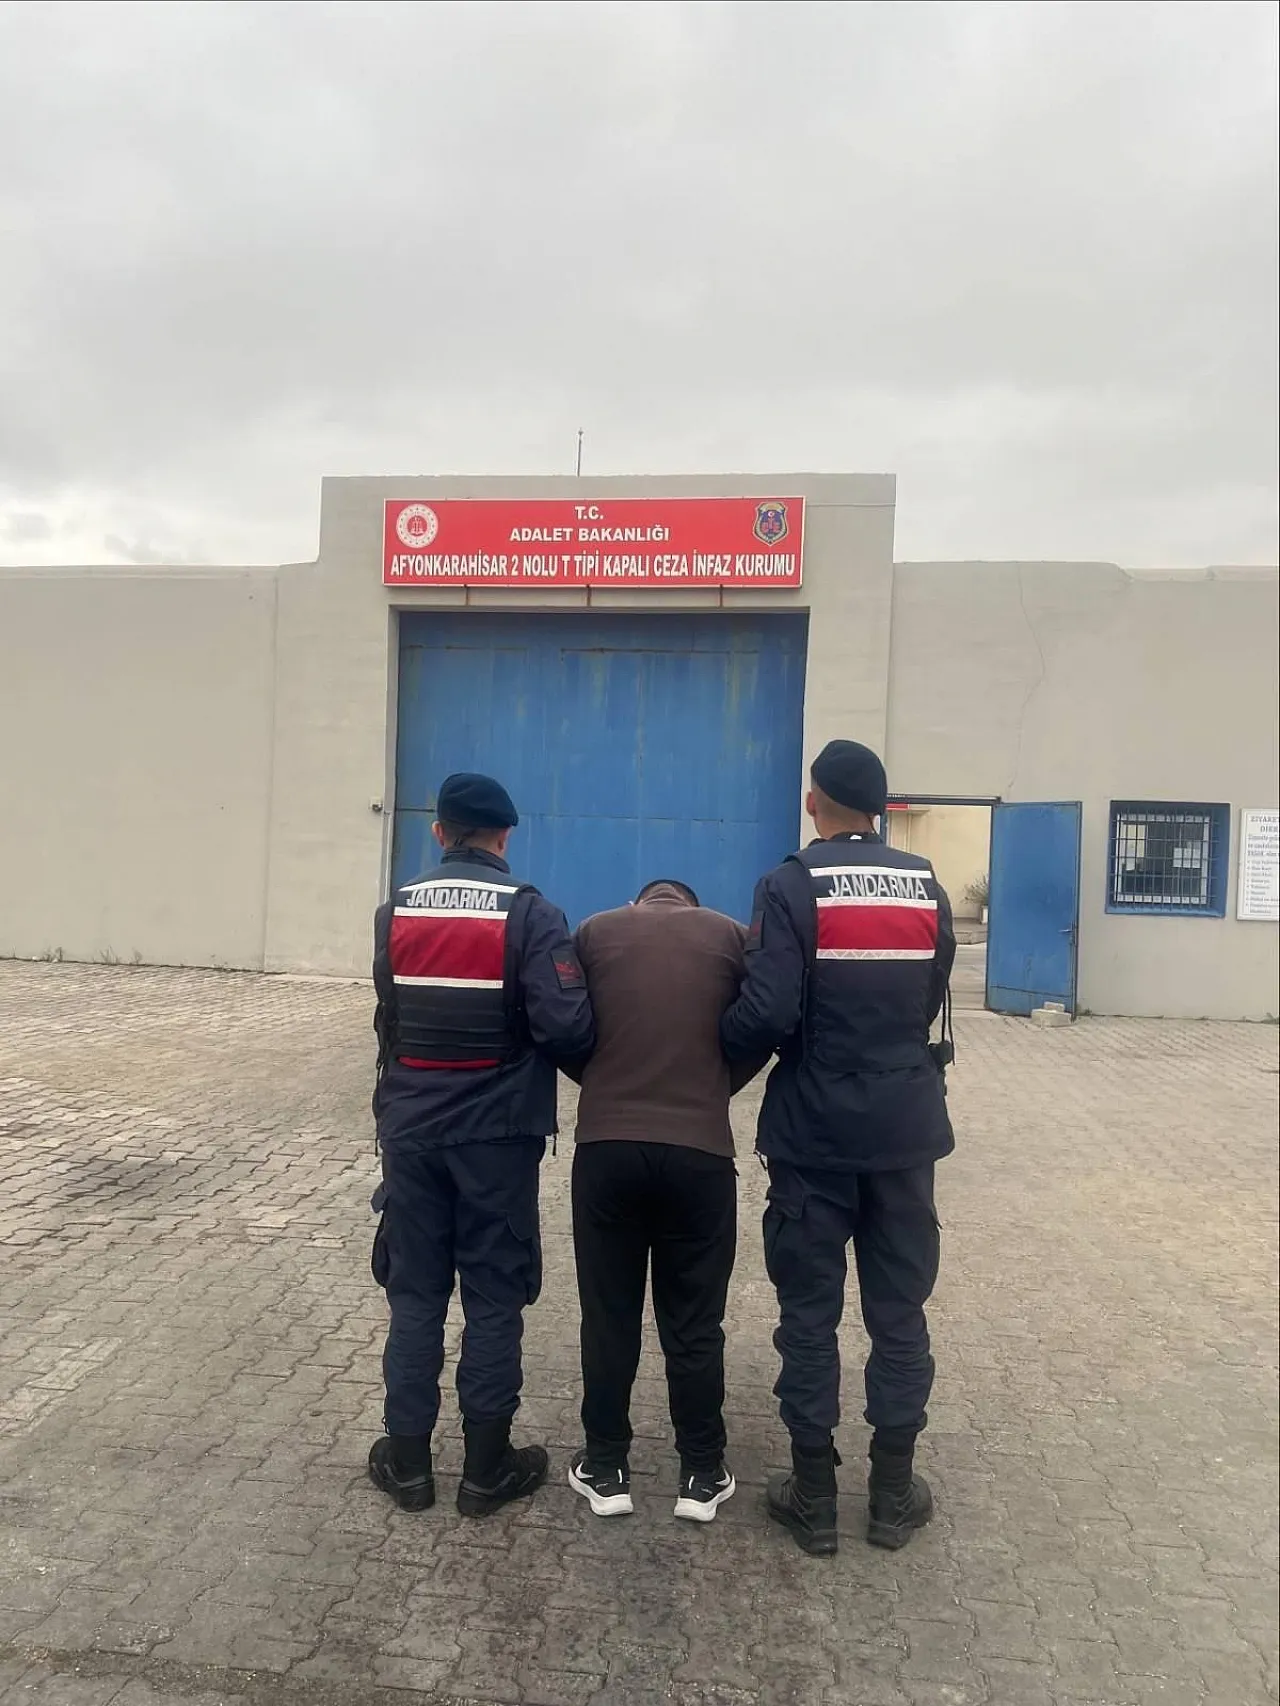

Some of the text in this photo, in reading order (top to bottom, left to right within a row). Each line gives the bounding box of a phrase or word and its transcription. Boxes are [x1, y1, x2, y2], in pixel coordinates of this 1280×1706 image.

[575, 506, 604, 519] T.C.
[510, 524, 670, 541] ADALET BAKANLIĞI
[390, 549, 795, 577] AFYONKARAHİSAR 2 NOLU T TİPİ KAPALI CEZA İNFAZ KURUMU
[406, 887, 499, 910] JANDARMA
[828, 874, 928, 900] JANDARMA
